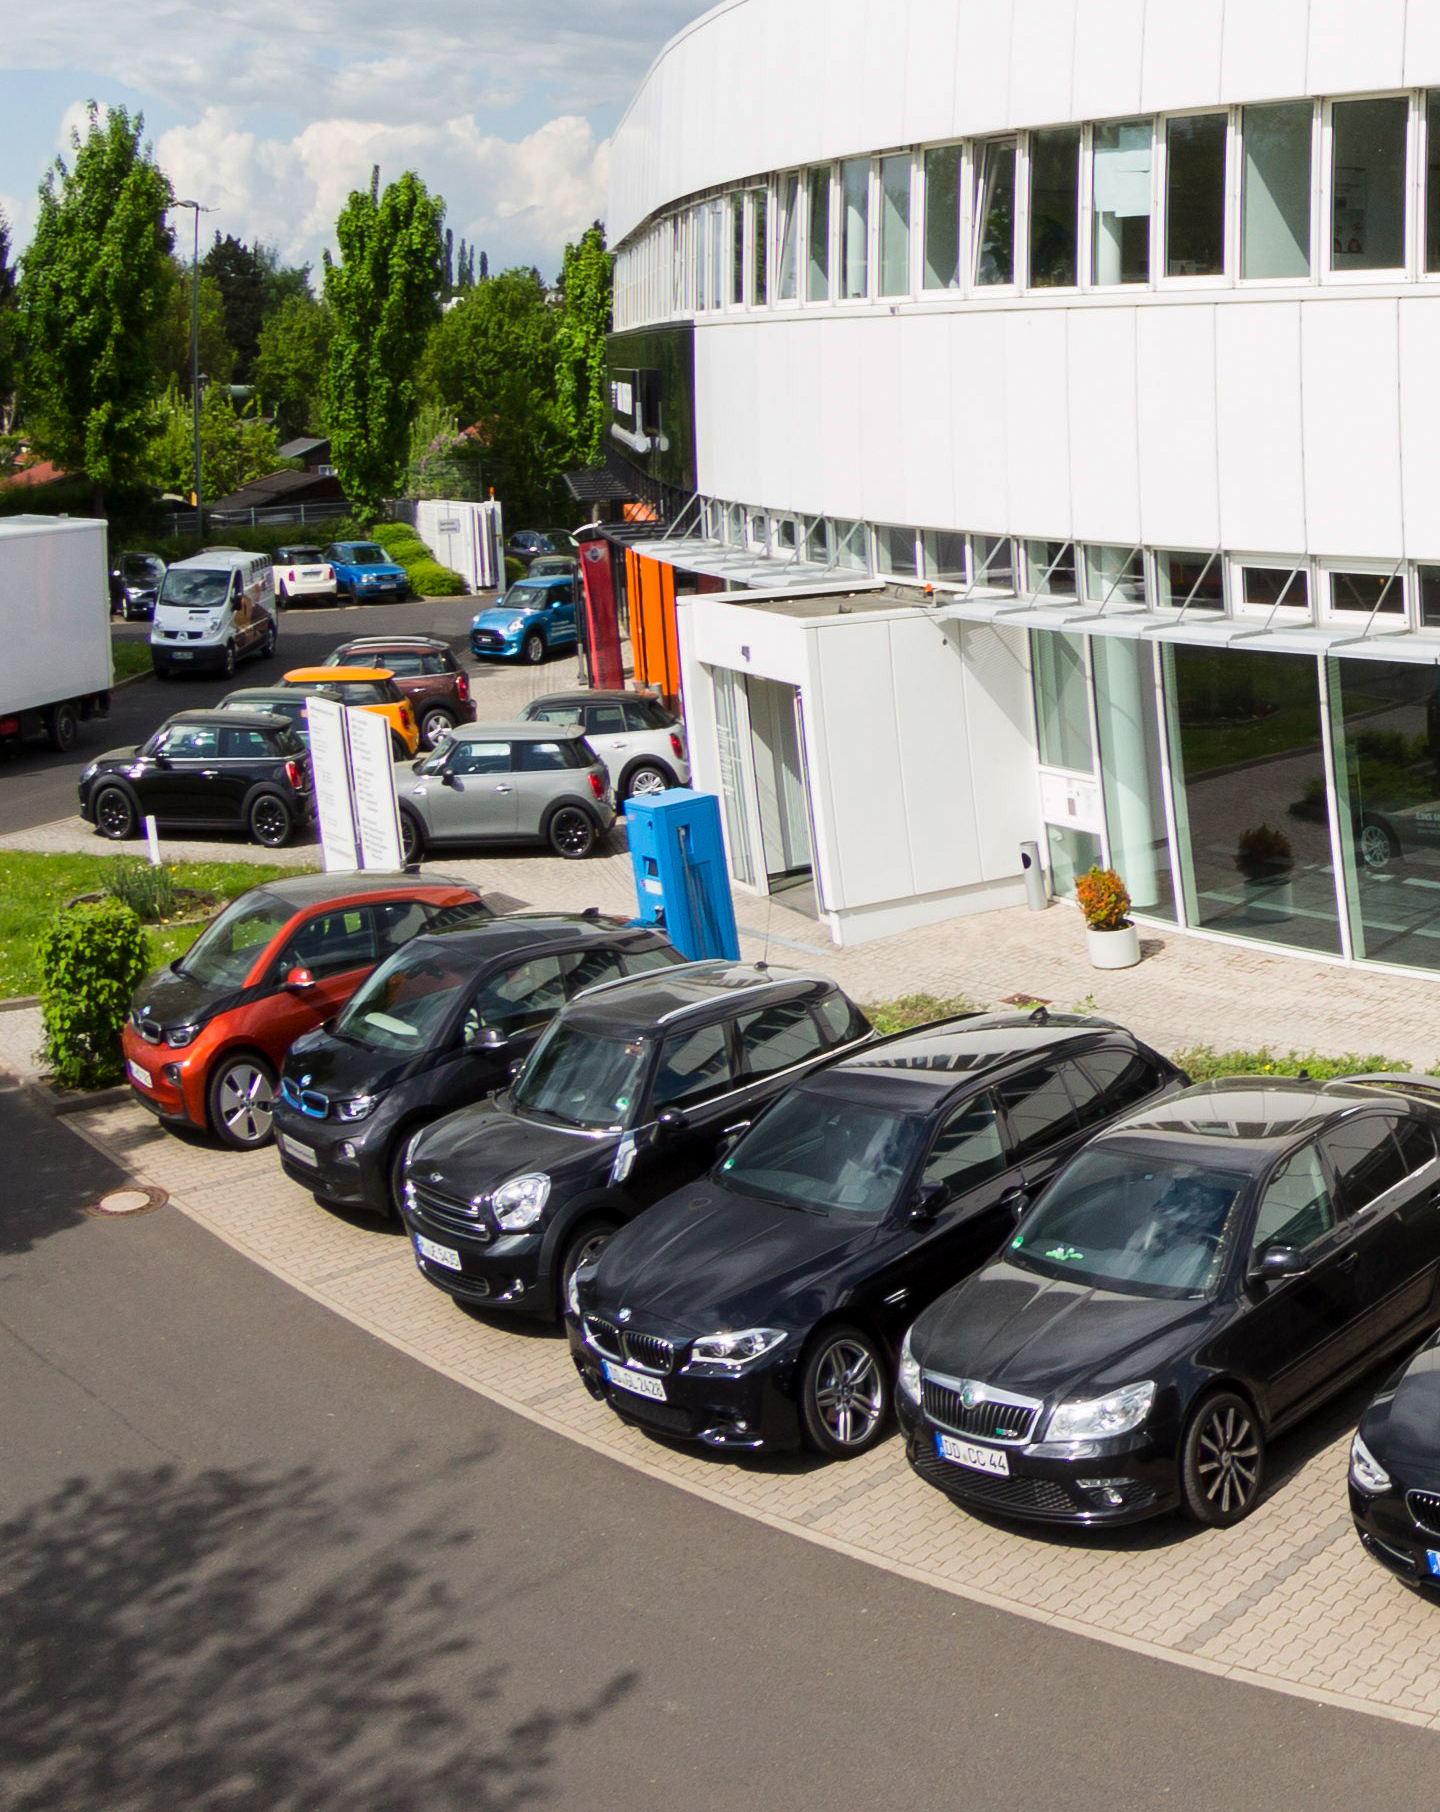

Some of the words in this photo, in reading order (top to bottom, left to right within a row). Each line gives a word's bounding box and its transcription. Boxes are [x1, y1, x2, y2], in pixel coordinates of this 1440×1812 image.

[944, 1439, 960, 1459] DD
[968, 1447, 986, 1466] CC
[989, 1453, 1007, 1471] 44
